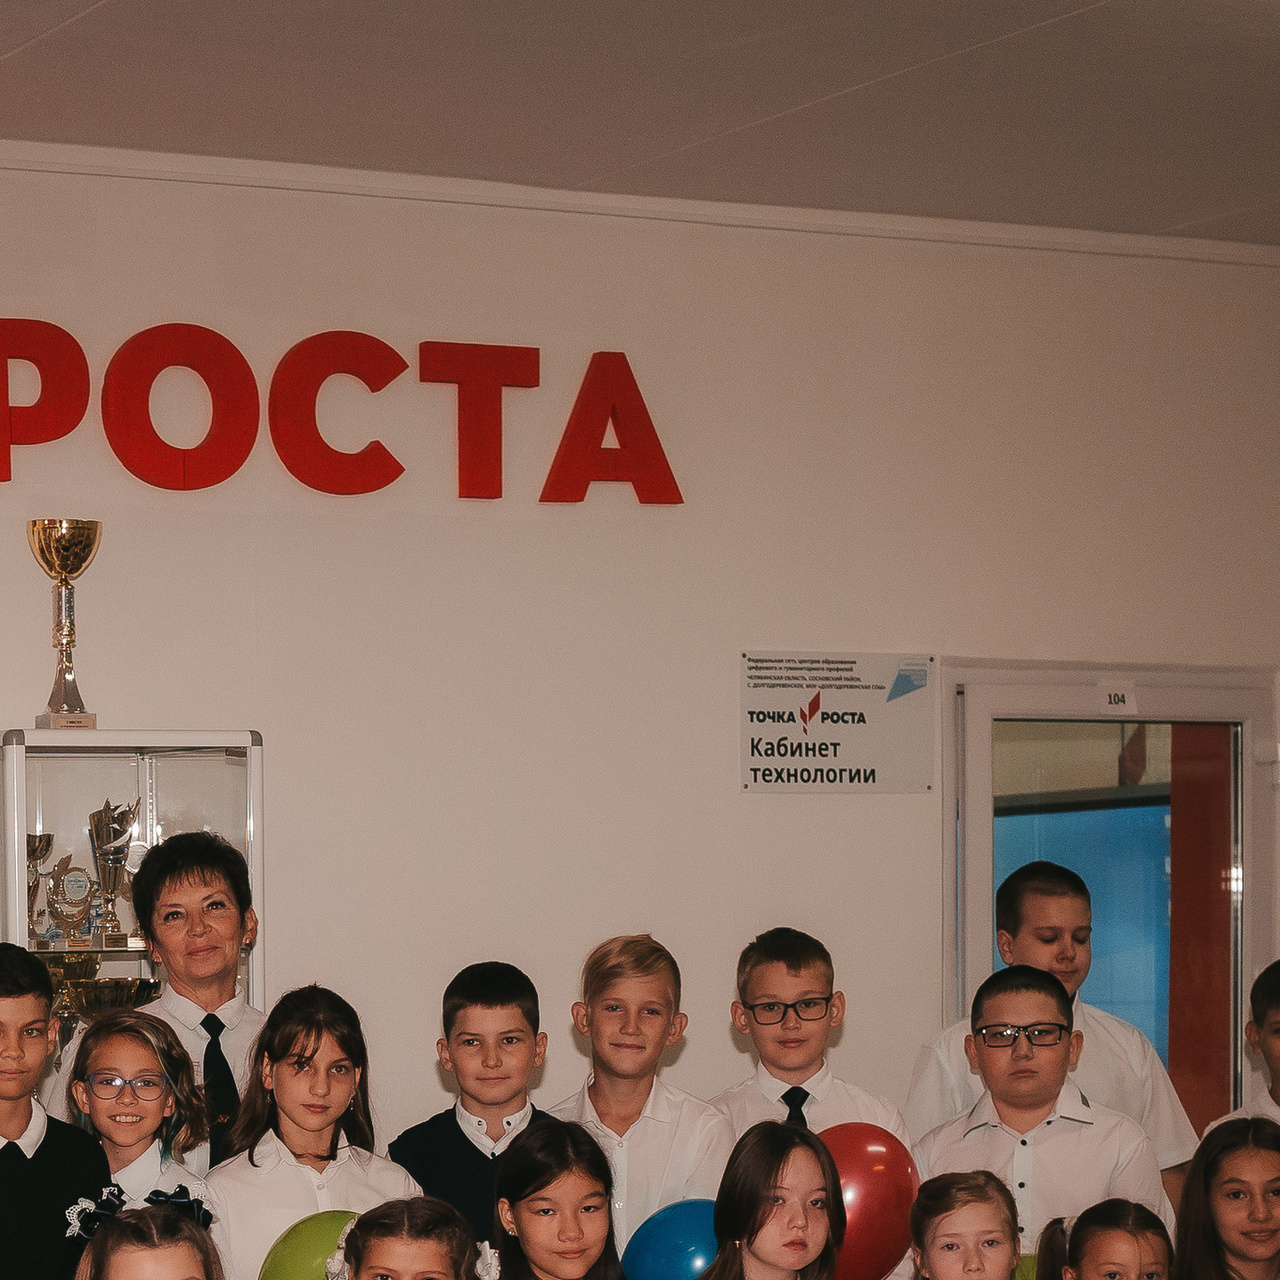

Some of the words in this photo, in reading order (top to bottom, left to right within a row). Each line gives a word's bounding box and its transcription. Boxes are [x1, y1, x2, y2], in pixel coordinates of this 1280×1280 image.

[1108, 693, 1126, 705] 104
[747, 710, 797, 724] ТОЧКА
[821, 711, 867, 725] РОСТА
[750, 736, 841, 758] Кабинет
[749, 767, 877, 784] технологии
